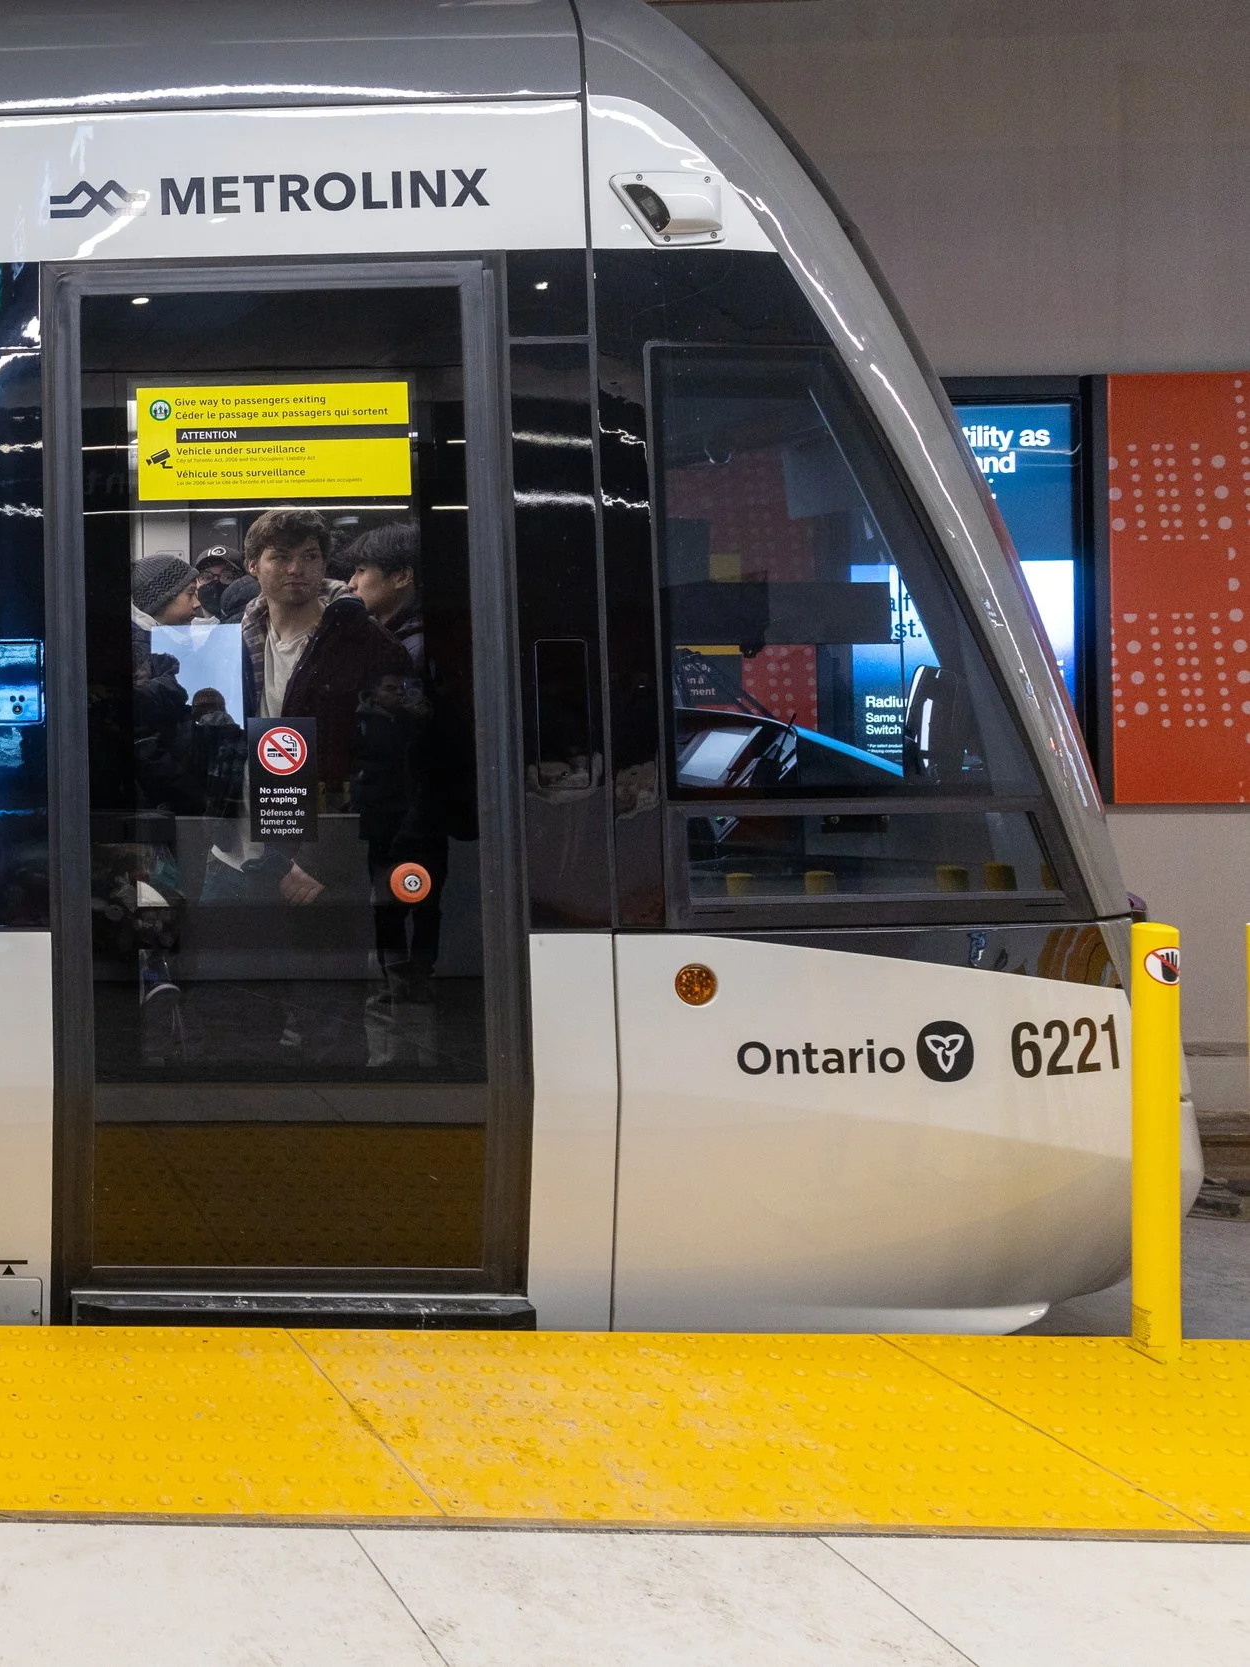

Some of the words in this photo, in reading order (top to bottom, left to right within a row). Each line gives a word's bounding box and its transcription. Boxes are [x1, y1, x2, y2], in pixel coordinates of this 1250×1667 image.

[160, 168, 491, 216] METROLINX
[235, 396, 290, 406] passengers
[293, 395, 326, 405] exiting
[176, 411, 204, 419] Céder
[207, 411, 216, 419] le
[220, 412, 258, 420] passage
[282, 410, 331, 419] passagers
[334, 408, 349, 418] qui
[353, 408, 388, 416] sortent
[181, 430, 237, 440] ATTENTION
[962, 426, 1014, 452] tility
[1020, 429, 1050, 446] as
[176, 447, 212, 455] Vehicle
[215, 447, 243, 455] under
[246, 446, 306, 454] surveillance
[176, 470, 217, 478] Véhicule
[221, 470, 243, 478] sous
[246, 468, 306, 477] surveillance
[866, 712, 896, 723] Same
[866, 725, 902, 735] Switch
[273, 787, 307, 796] smoking
[271, 796, 298, 804] vaping
[273, 828, 304, 836] vapoter
[1010, 1014, 1121, 1078] 6221
[737, 1039, 906, 1076] Ontario
